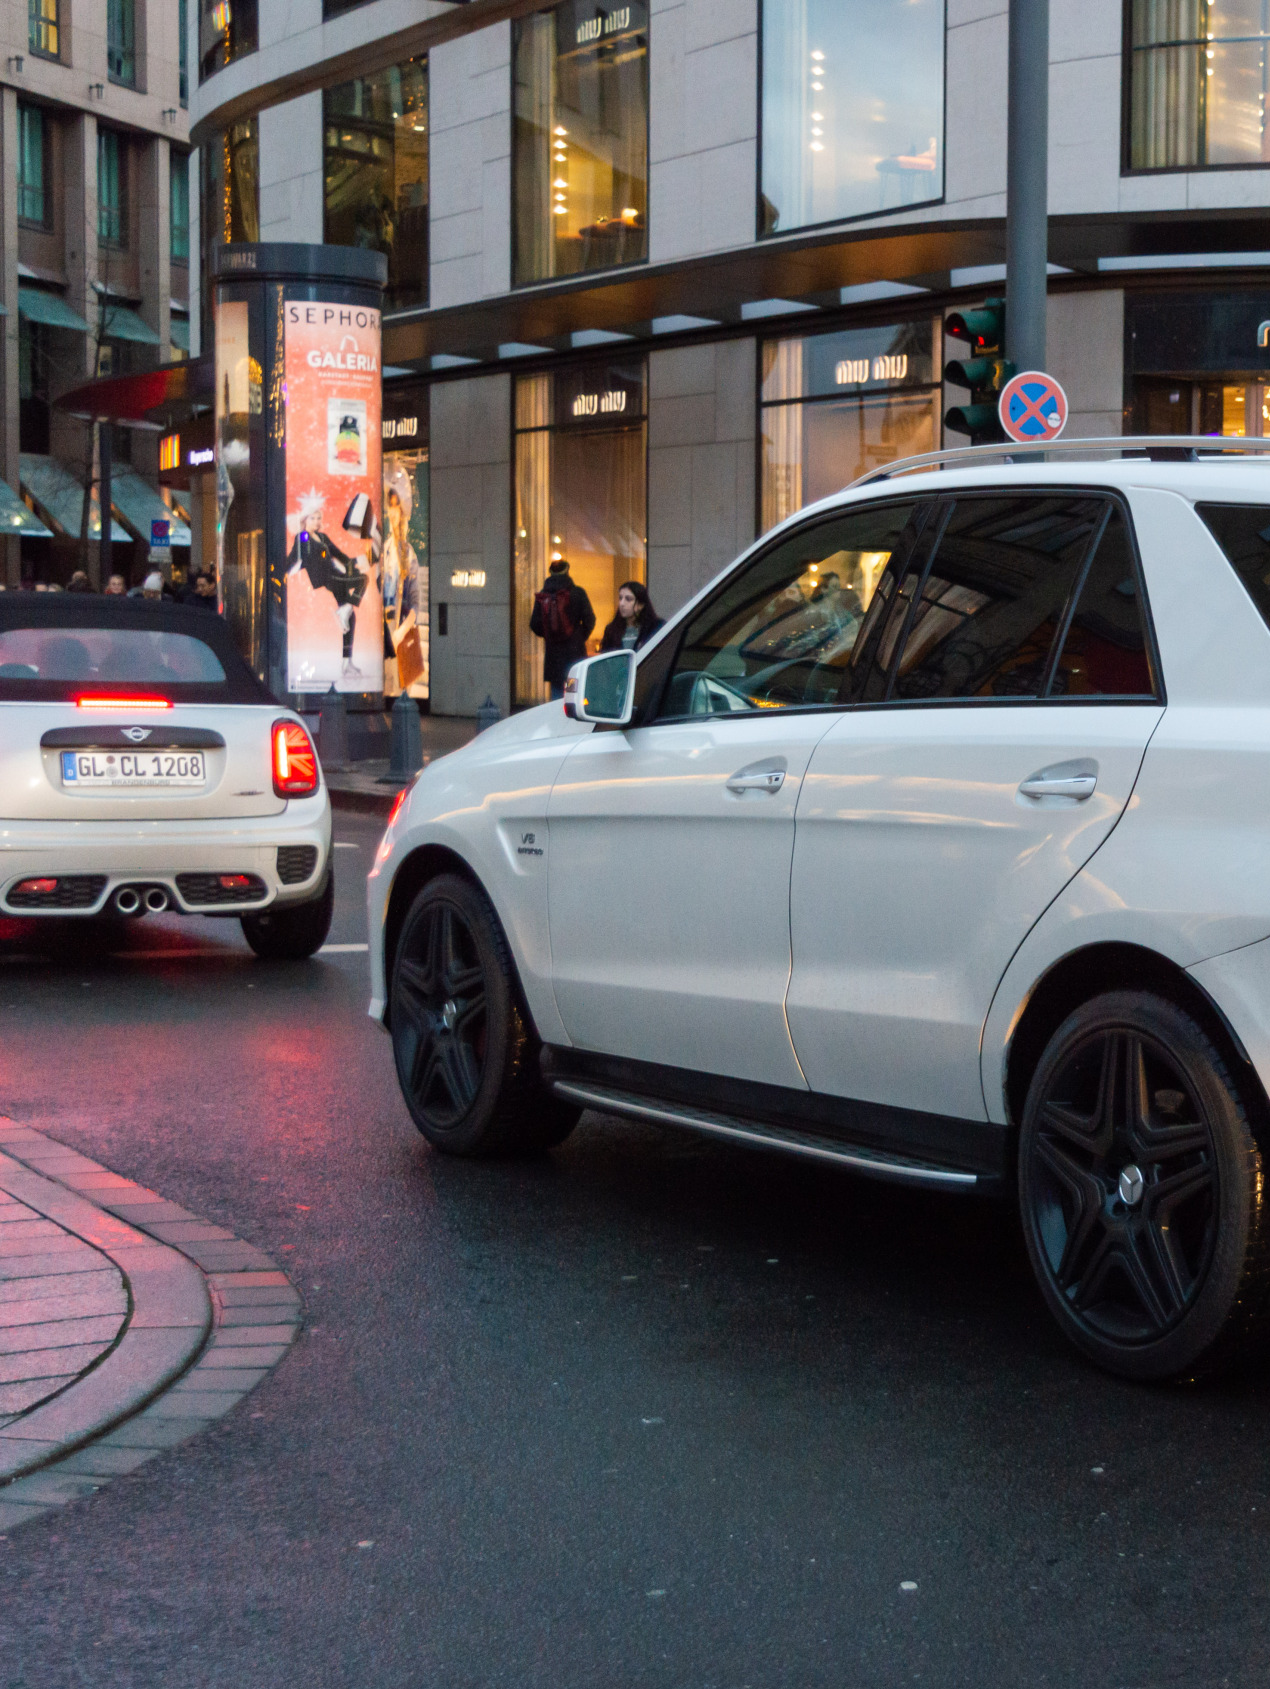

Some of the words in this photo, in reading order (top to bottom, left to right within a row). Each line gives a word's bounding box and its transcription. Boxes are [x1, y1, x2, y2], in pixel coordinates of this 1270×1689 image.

[307, 349, 378, 372] GALERIA
[78, 756, 105, 777] GL
[121, 756, 146, 777] CL
[152, 756, 201, 777] 1208
